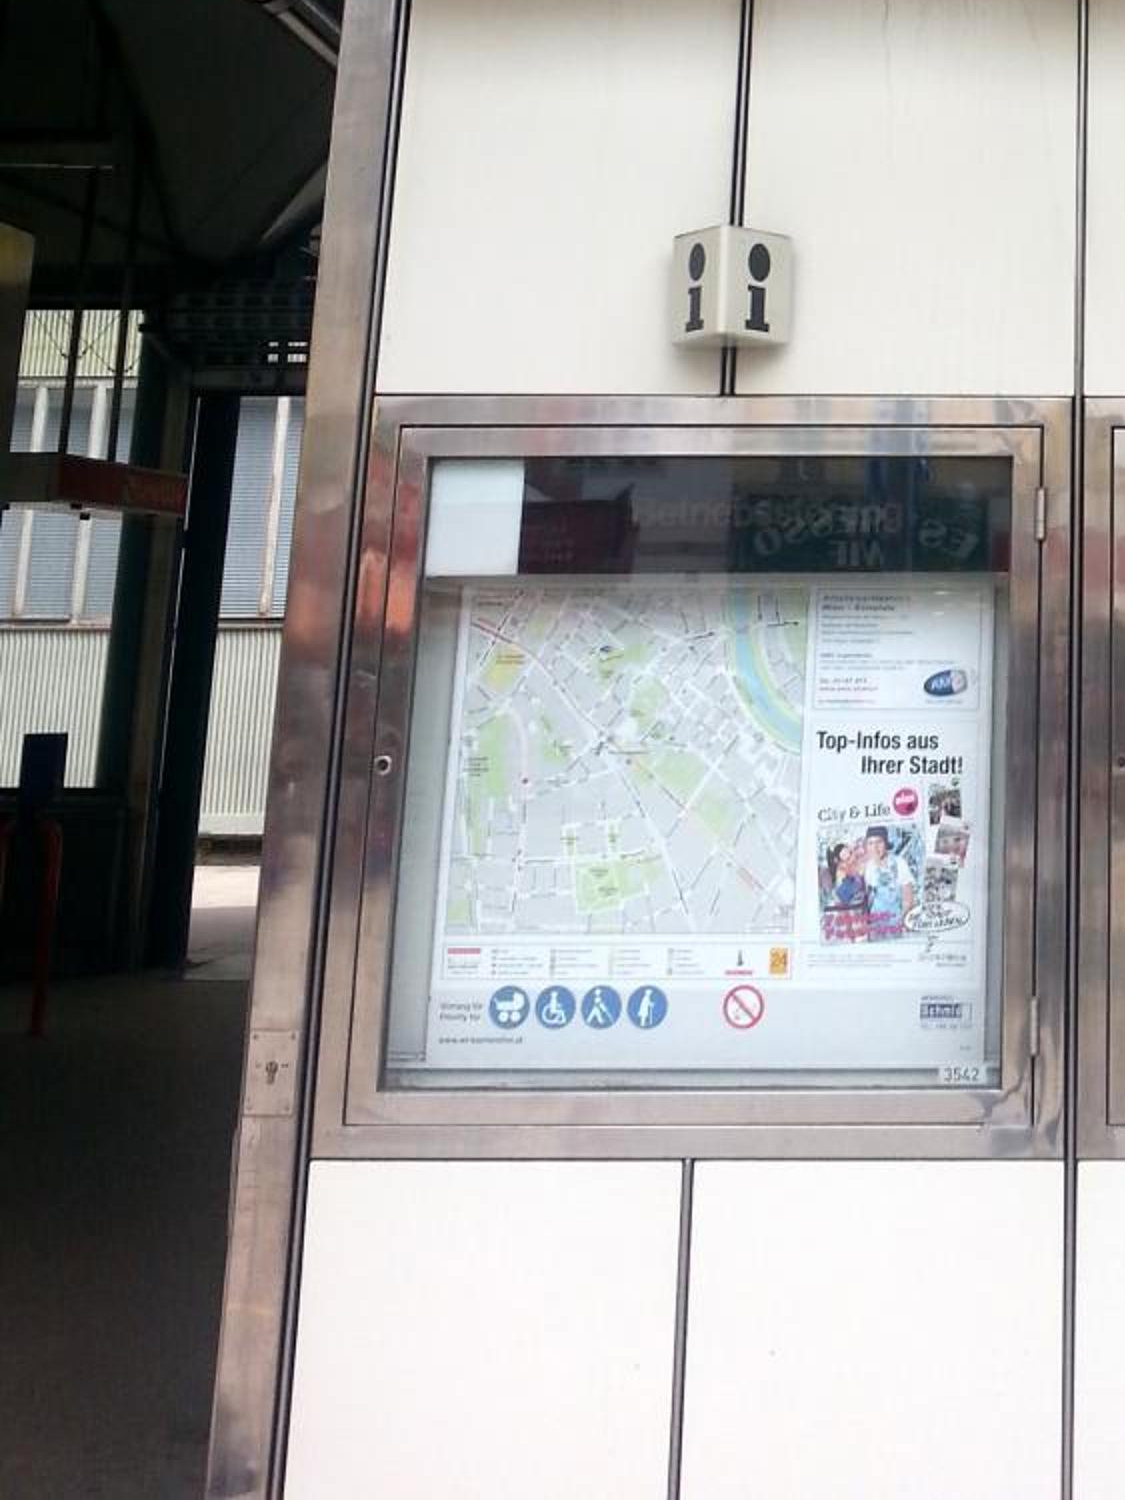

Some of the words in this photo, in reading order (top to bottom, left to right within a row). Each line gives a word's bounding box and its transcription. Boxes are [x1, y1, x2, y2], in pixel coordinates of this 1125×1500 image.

[817, 730, 901, 753] Top-Infos
[906, 735, 939, 750] aus
[861, 755, 904, 774] Ihrer
[909, 755, 965, 775] Stadt!
[817, 806, 846, 823] City
[943, 1067, 981, 1083] 3542
